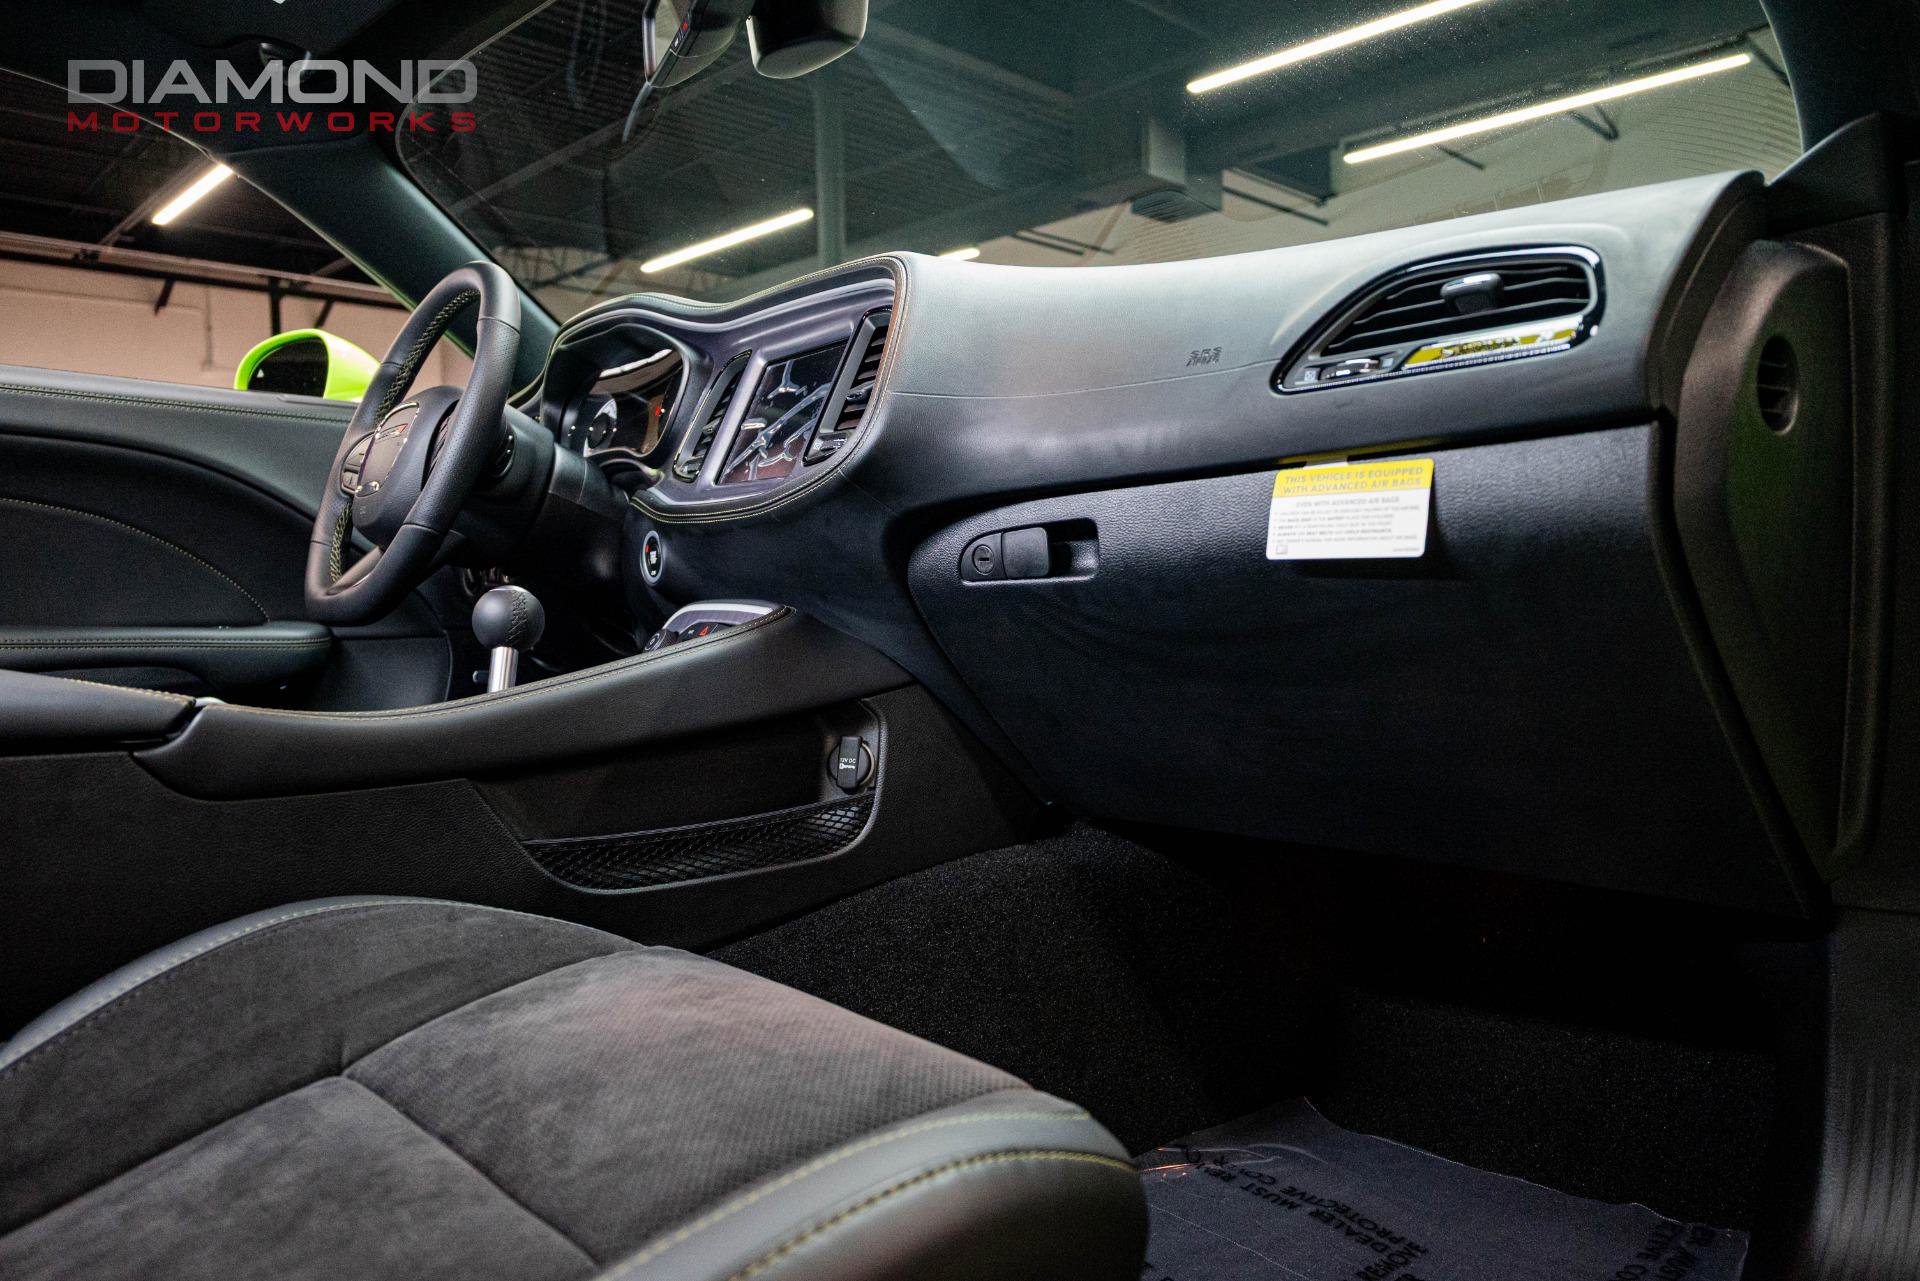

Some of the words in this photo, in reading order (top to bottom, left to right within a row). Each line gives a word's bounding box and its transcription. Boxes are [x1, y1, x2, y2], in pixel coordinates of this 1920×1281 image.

[1283, 485, 1309, 495] WITH
[1310, 480, 1368, 492] ADVANCED
[1371, 479, 1390, 489] AIR
[1391, 477, 1422, 488] BAGS
[1285, 475, 1307, 484] THIS
[1310, 471, 1352, 482] VEHICLE
[1355, 470, 1365, 479] IS
[1368, 466, 1424, 478] EQUIPPED
[1240, 1182, 1301, 1211] MUST
[1281, 1184, 1409, 1248] PROTECTIVE
[1308, 1209, 1389, 1254] DEALER
